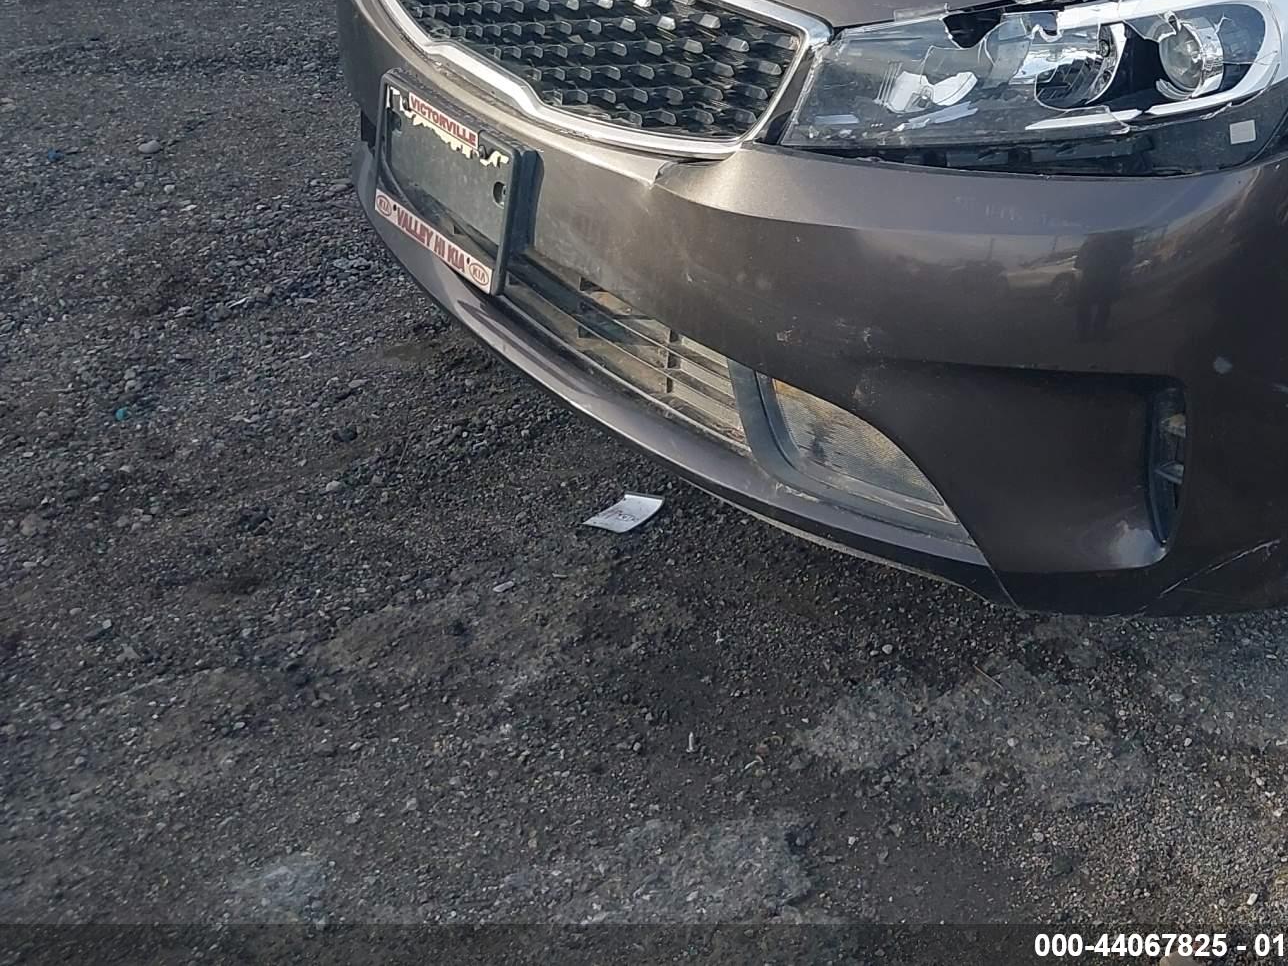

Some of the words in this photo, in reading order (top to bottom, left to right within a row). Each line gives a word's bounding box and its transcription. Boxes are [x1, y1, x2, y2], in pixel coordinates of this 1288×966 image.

[410, 94, 477, 147] VICTORVILLE
[397, 206, 434, 247] VALLEY
[433, 235, 446, 258] HI
[447, 244, 466, 273] KIA
